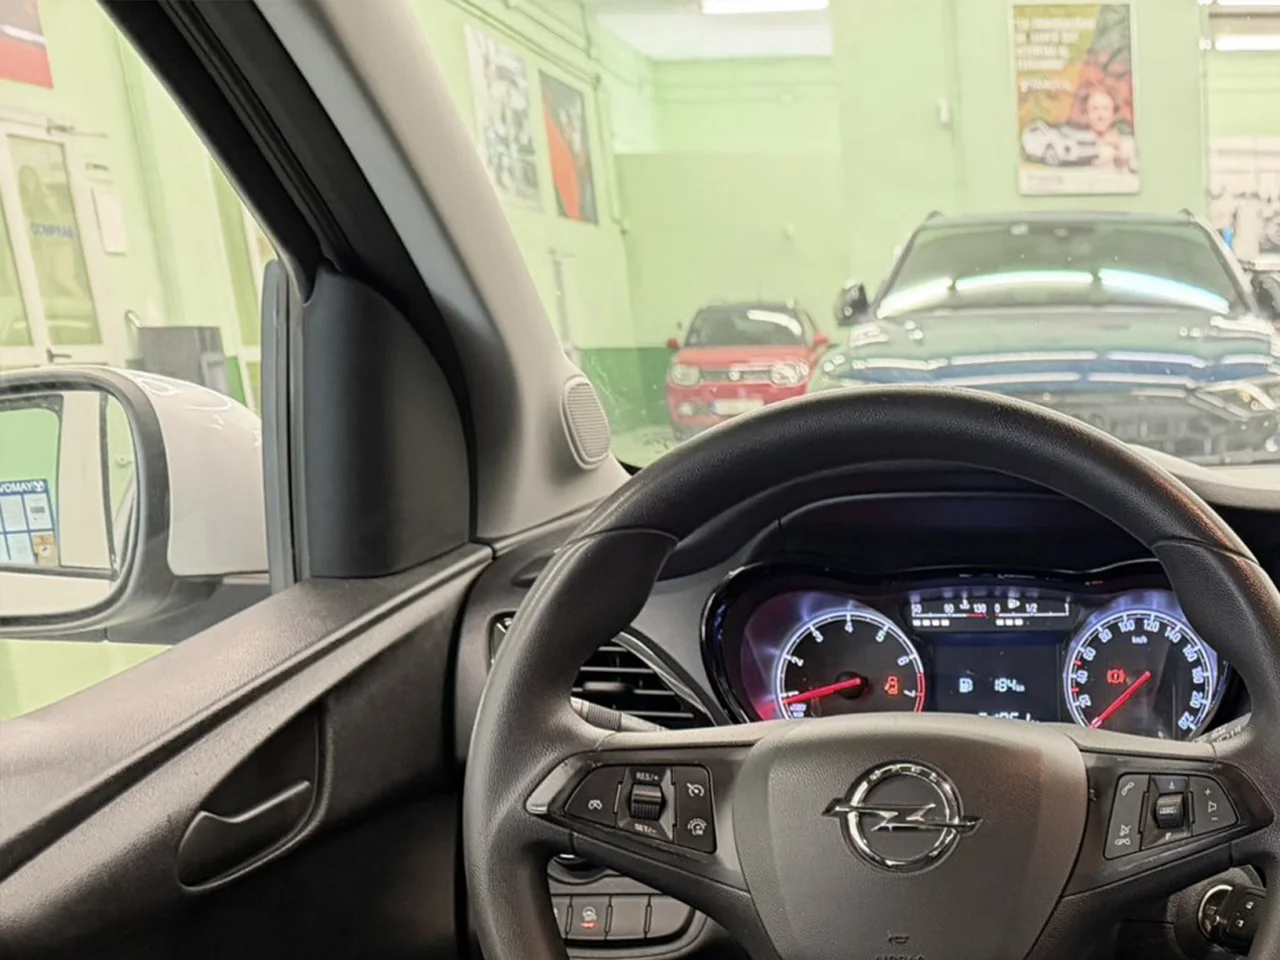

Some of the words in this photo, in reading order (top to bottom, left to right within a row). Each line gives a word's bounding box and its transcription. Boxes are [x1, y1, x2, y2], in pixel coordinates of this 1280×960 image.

[1118, 619, 1135, 632] 100
[1143, 620, 1160, 632] 120
[1164, 626, 1182, 643] 140
[994, 678, 1016, 692] 184
